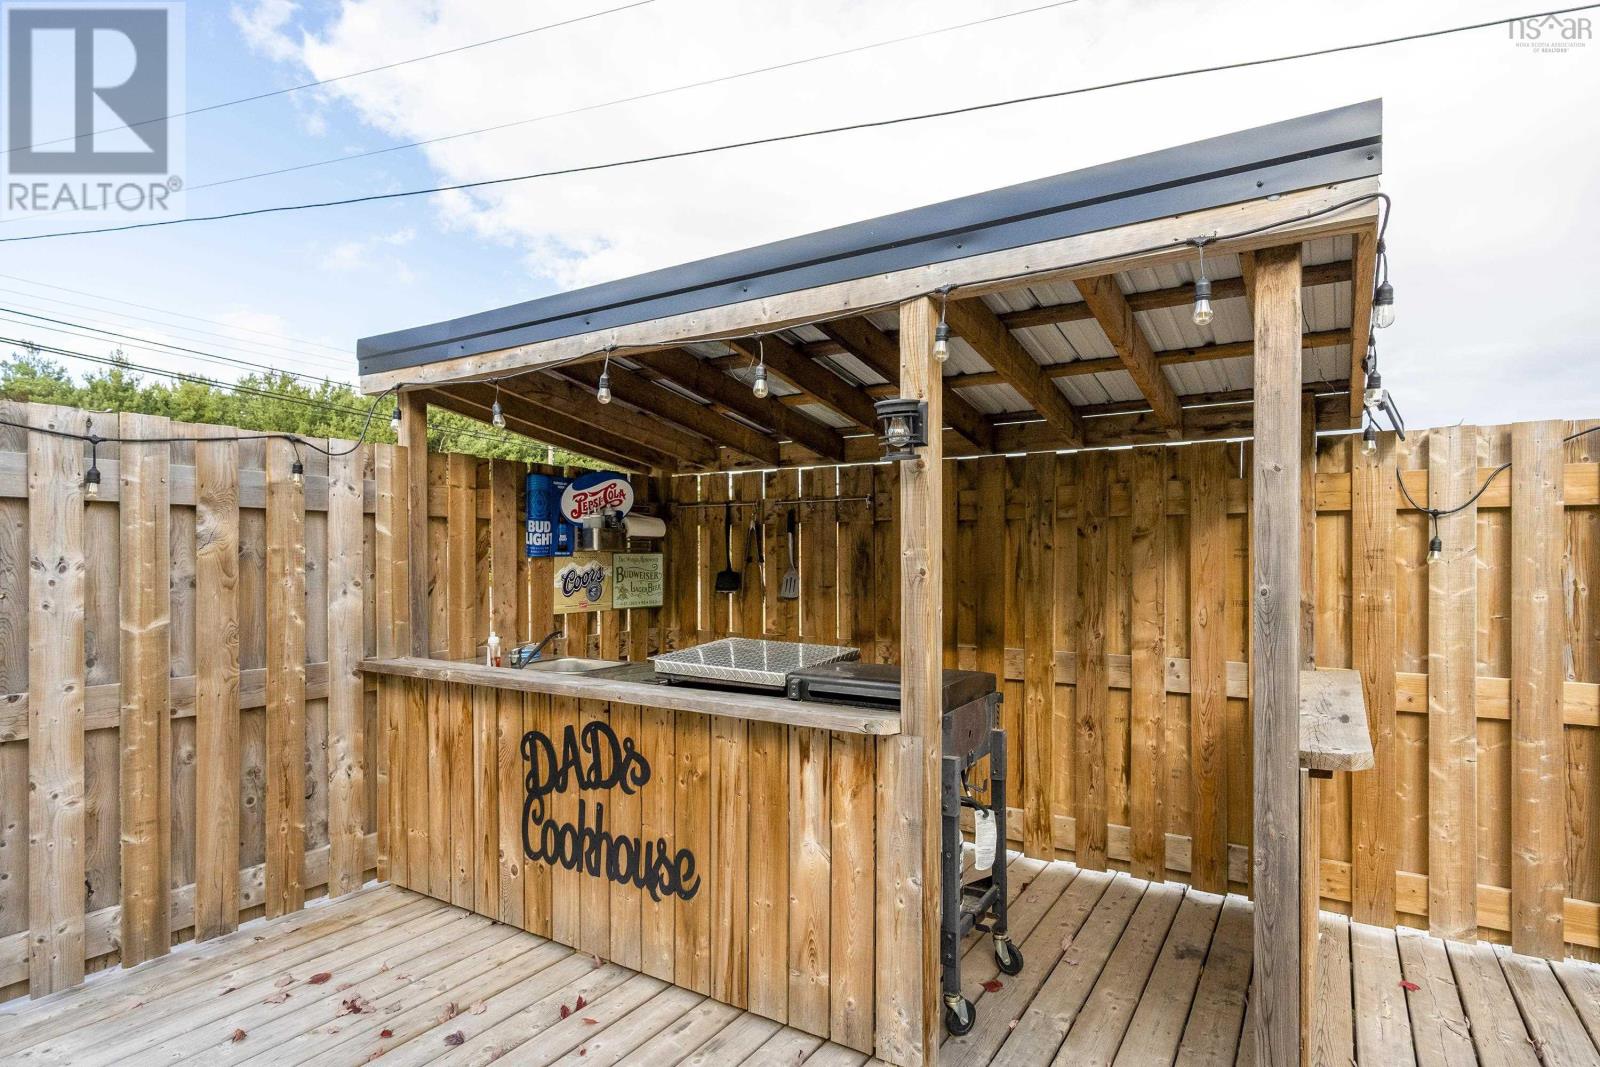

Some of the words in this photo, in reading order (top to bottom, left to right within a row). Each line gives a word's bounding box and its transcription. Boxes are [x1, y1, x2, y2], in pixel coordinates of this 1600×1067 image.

[528, 520, 551, 533] BUD
[561, 566, 605, 597] Coors
[522, 795, 701, 902] Cookhouse
